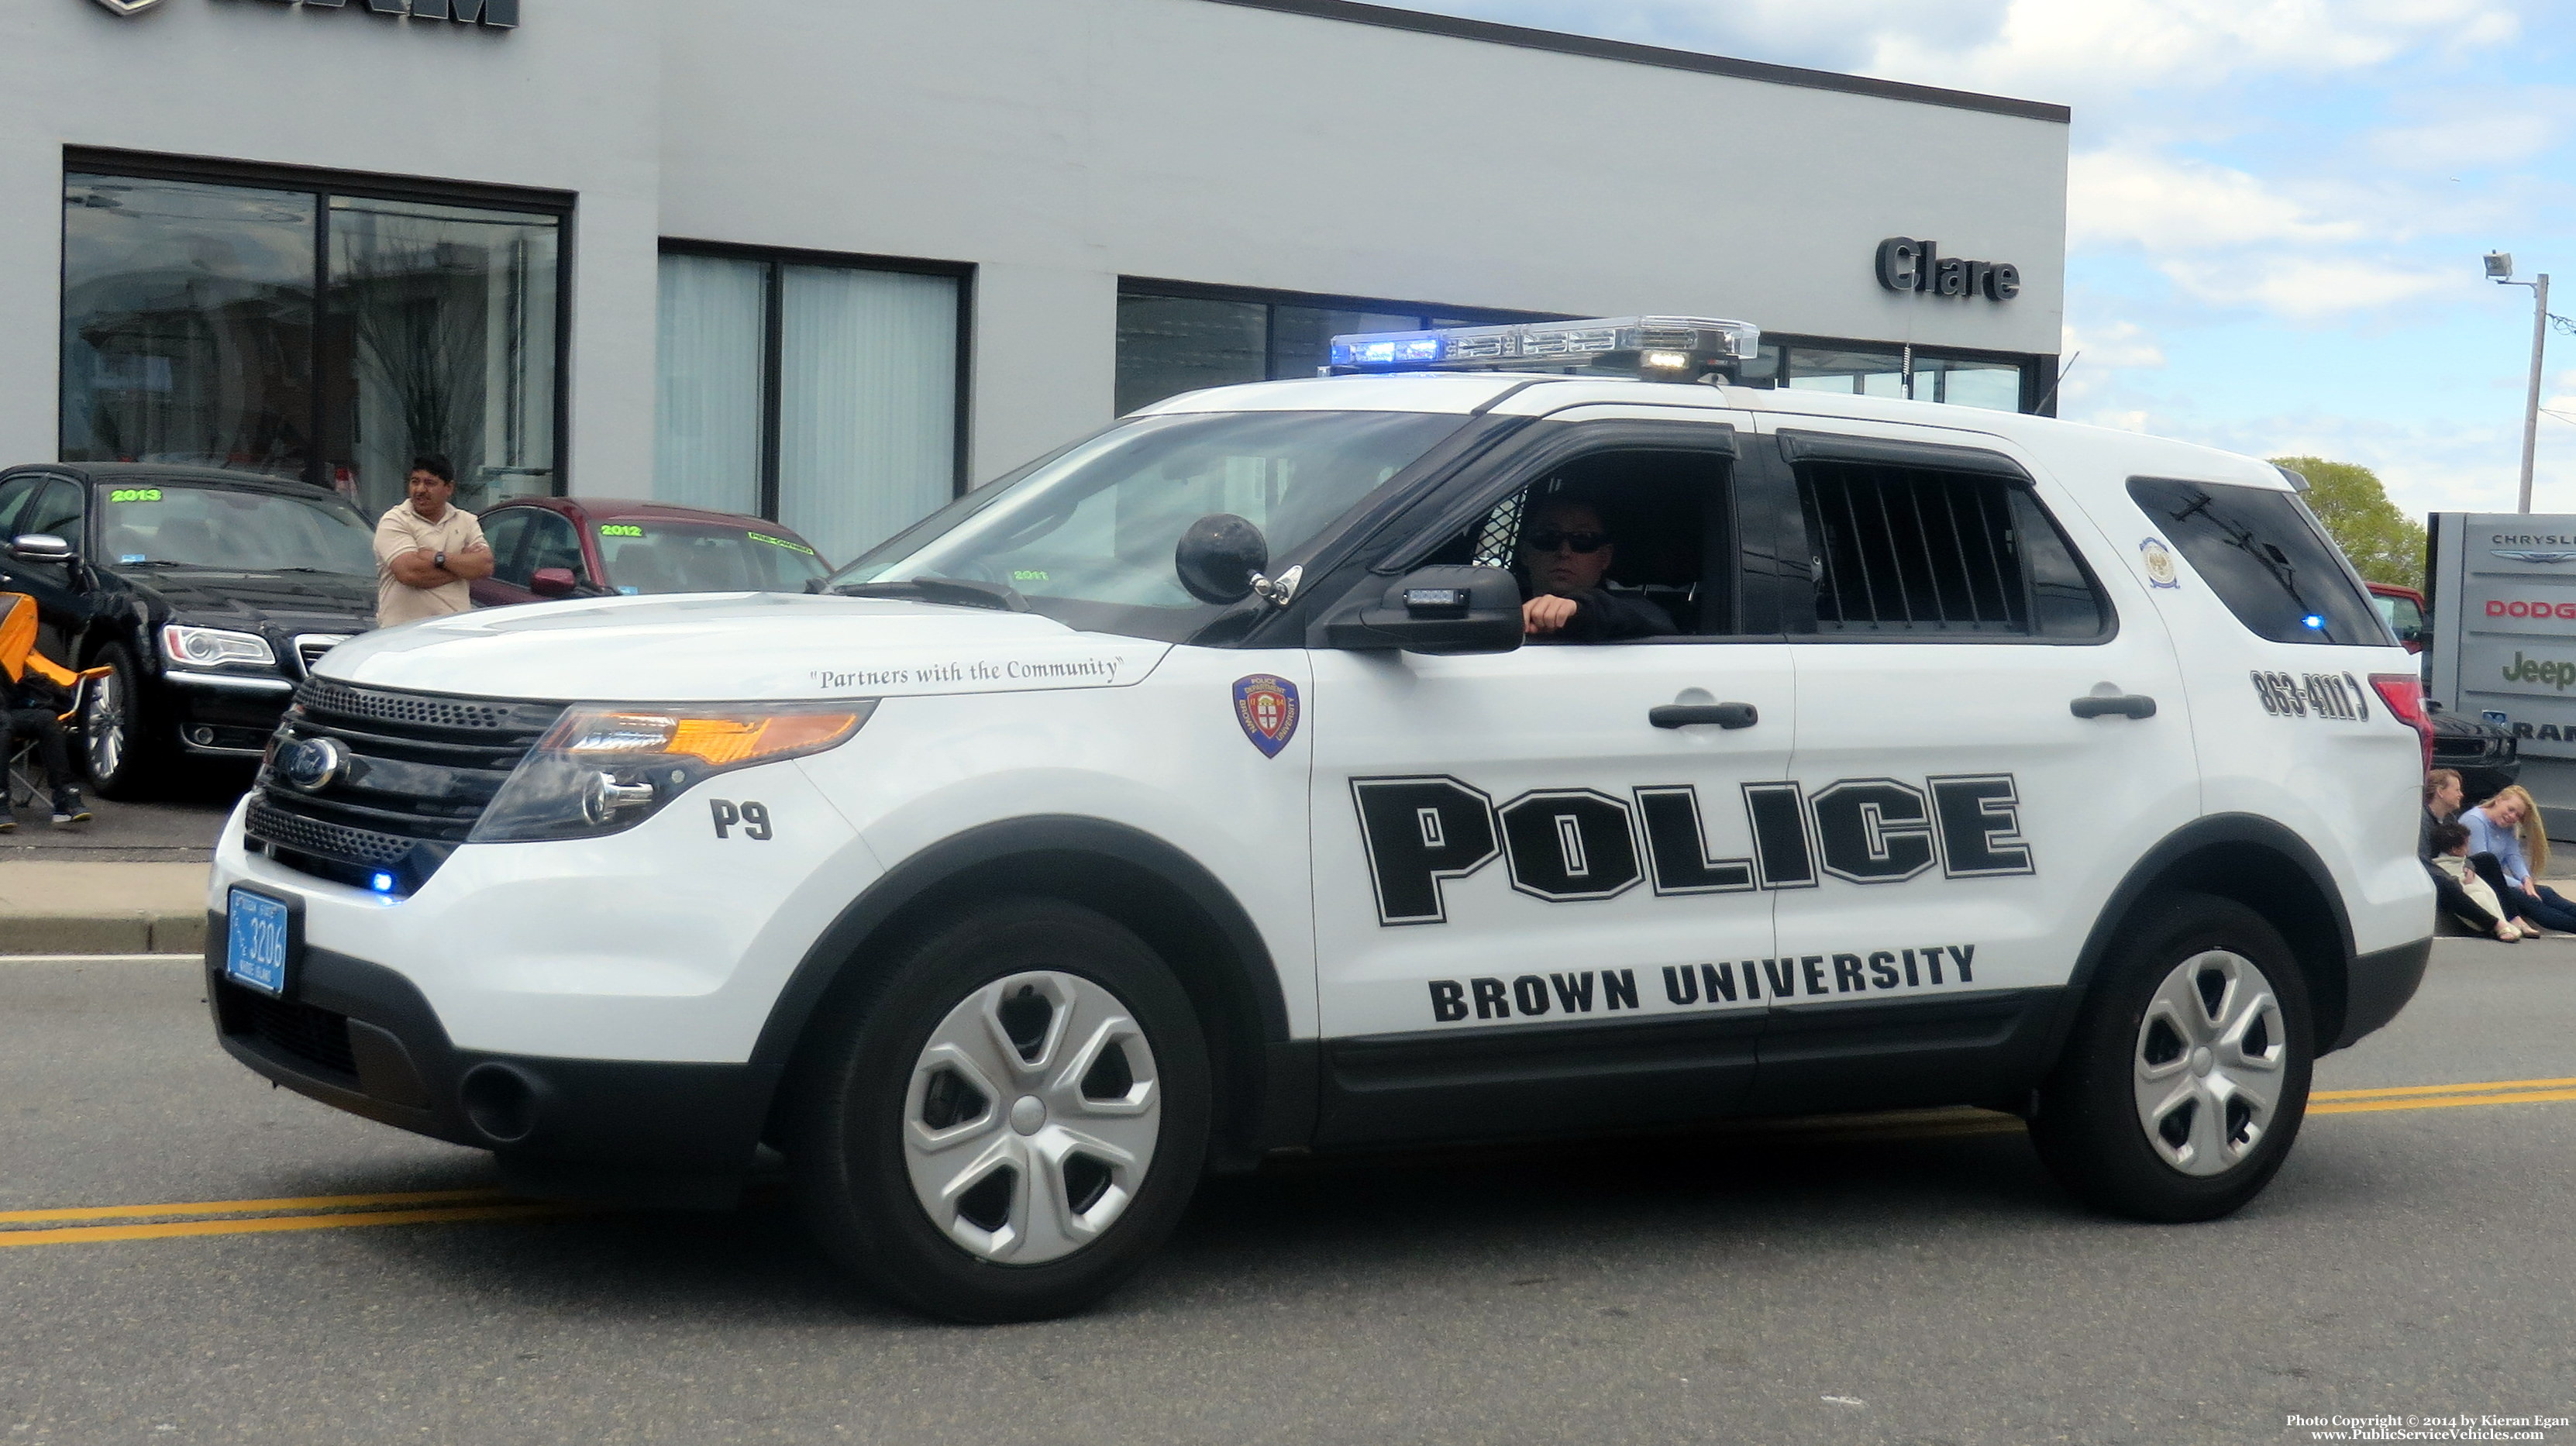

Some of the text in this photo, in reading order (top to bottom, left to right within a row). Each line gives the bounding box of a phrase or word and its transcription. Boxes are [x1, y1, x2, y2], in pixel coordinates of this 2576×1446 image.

[1875, 236, 2021, 301] Clare
[111, 489, 162, 503] 2013
[601, 525, 642, 537] 2012
[2492, 535, 2576, 545] CHRYSL
[916, 661, 963, 682] with
[969, 659, 1001, 680] the
[2502, 651, 2575, 691] Jeep
[1239, 699, 1257, 734] BROWN
[2250, 670, 2357, 721] 863-4111
[1275, 697, 1295, 742] UNIVERSITY
[710, 798, 773, 840] P9
[1351, 773, 2037, 927] POLICE
[250, 917, 282, 968] 3206
[1428, 943, 1976, 1023] BROWN UNIVERSITY
